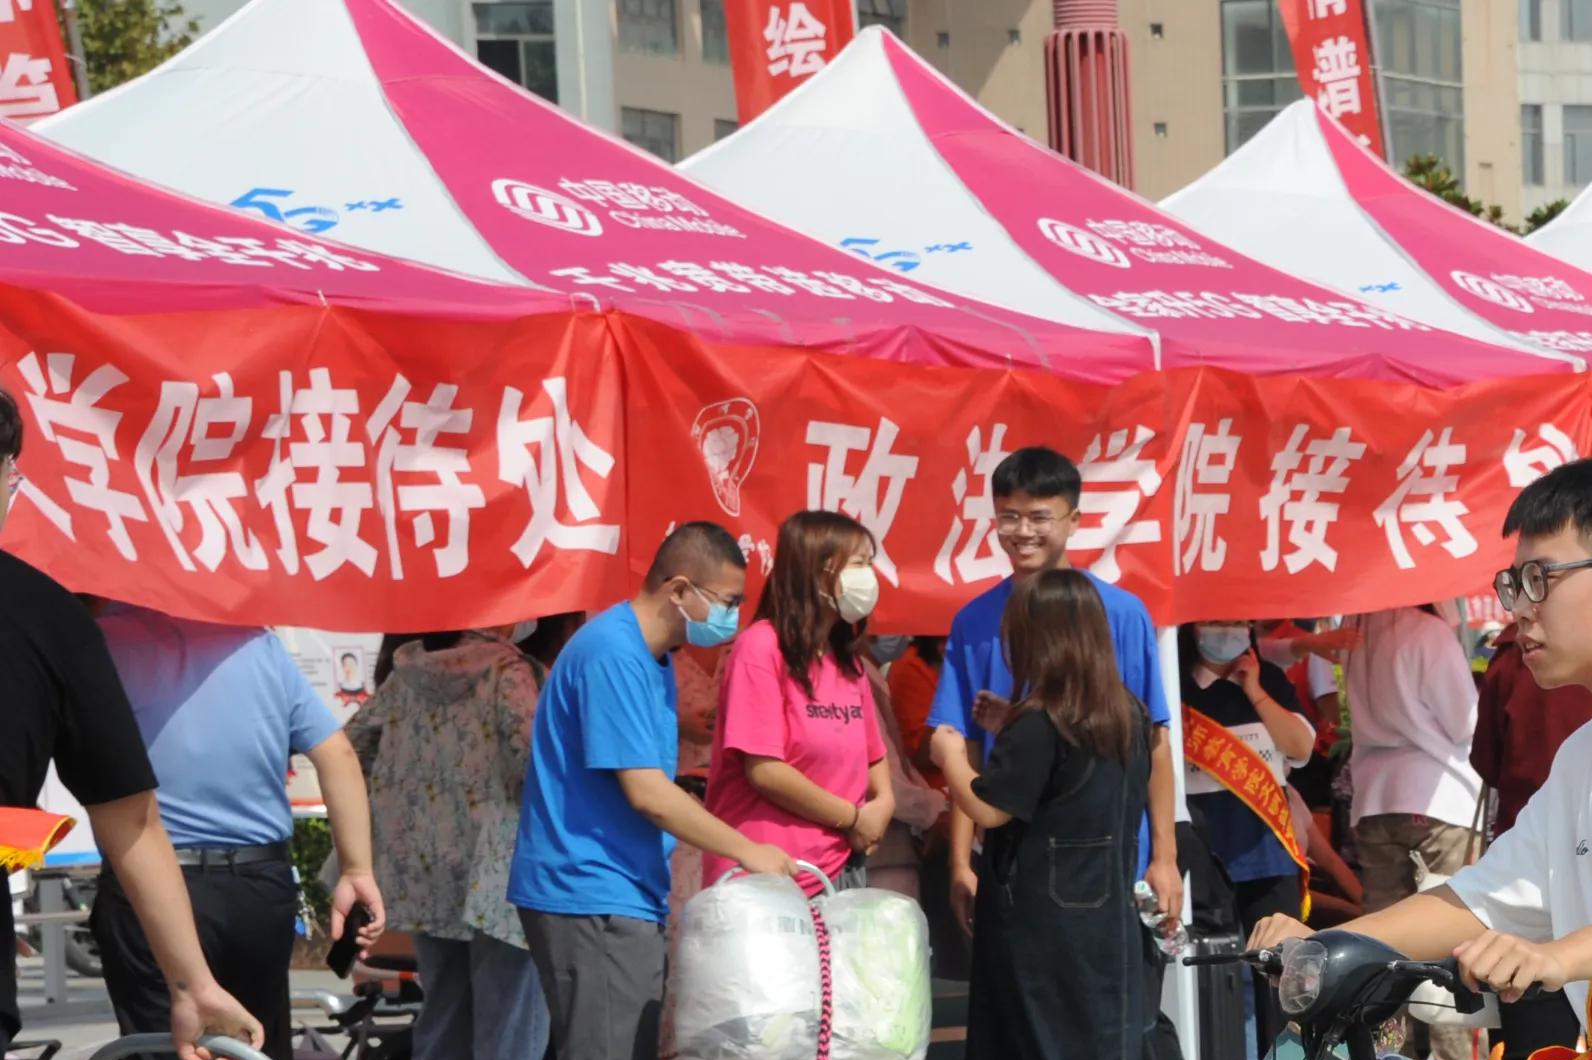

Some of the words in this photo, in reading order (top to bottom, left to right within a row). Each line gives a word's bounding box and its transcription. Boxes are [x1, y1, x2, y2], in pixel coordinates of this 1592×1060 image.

[763, 2, 826, 78] 绘
[559, 176, 710, 217] 中国移动
[11, 351, 620, 582] 学院接待处
